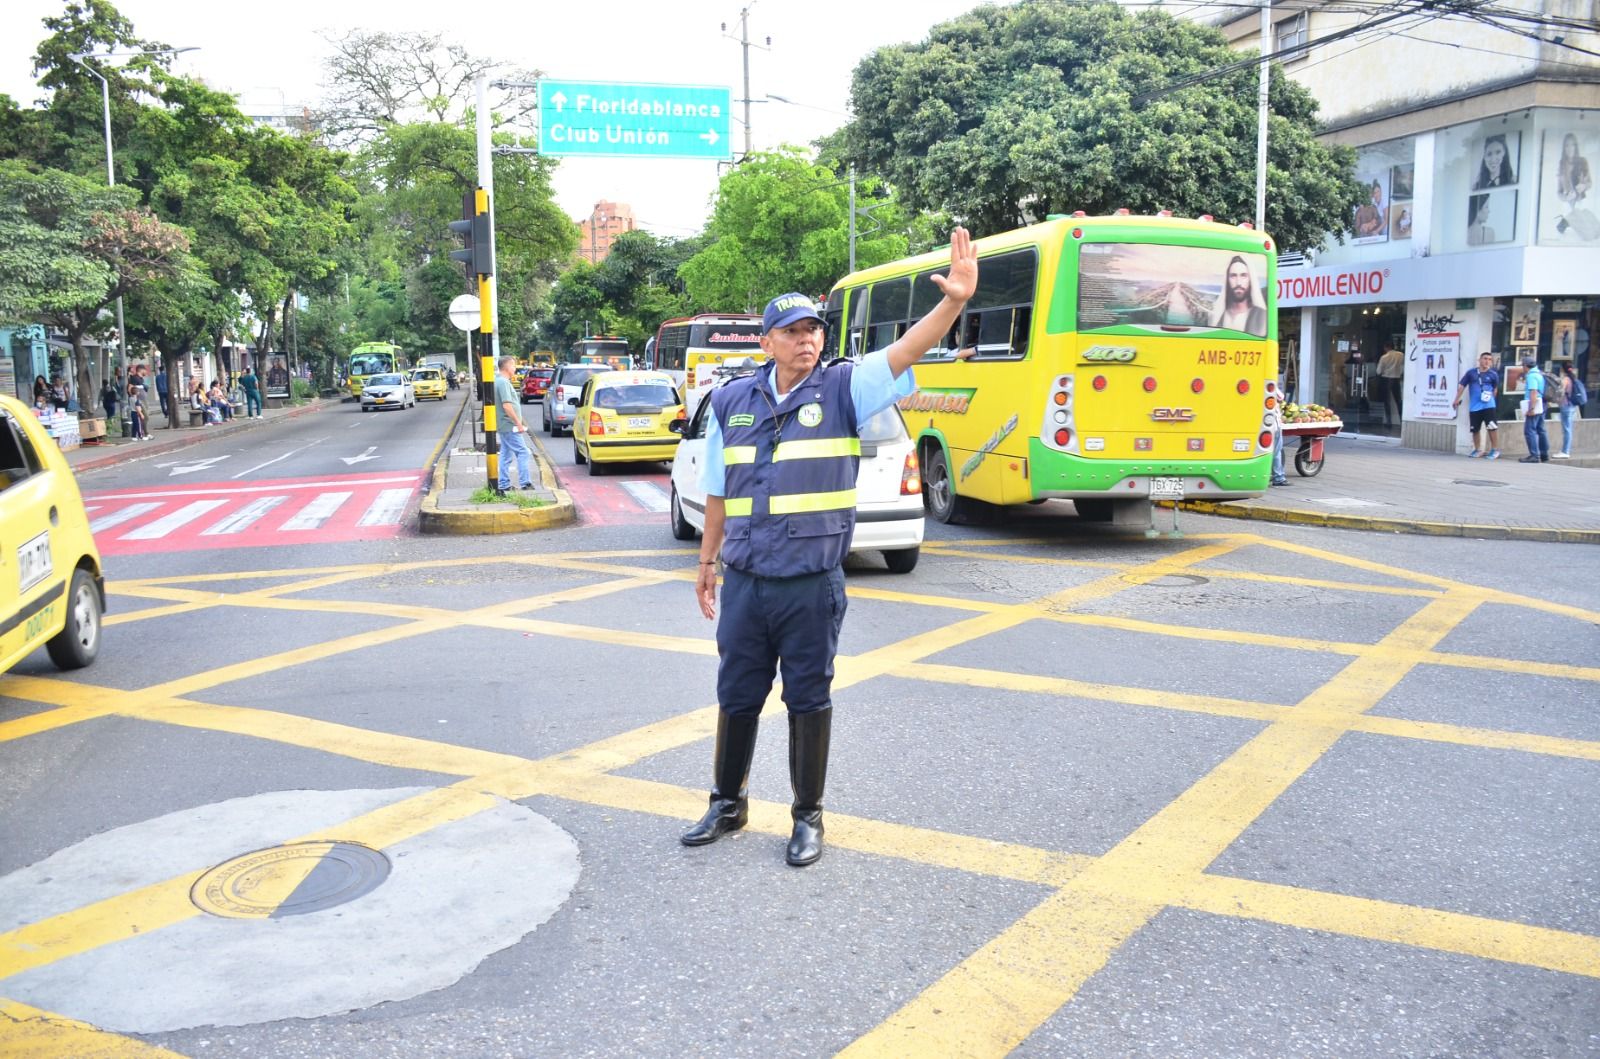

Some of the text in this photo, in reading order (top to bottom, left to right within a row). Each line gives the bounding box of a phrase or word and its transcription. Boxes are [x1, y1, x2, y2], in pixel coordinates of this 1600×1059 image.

[576, 95, 721, 117] Floridablanca
[550, 124, 670, 144] Club Unión
[1082, 345, 1137, 363] 406
[1197, 350, 1262, 366] AMB-0737
[1152, 409, 1192, 418] GMC
